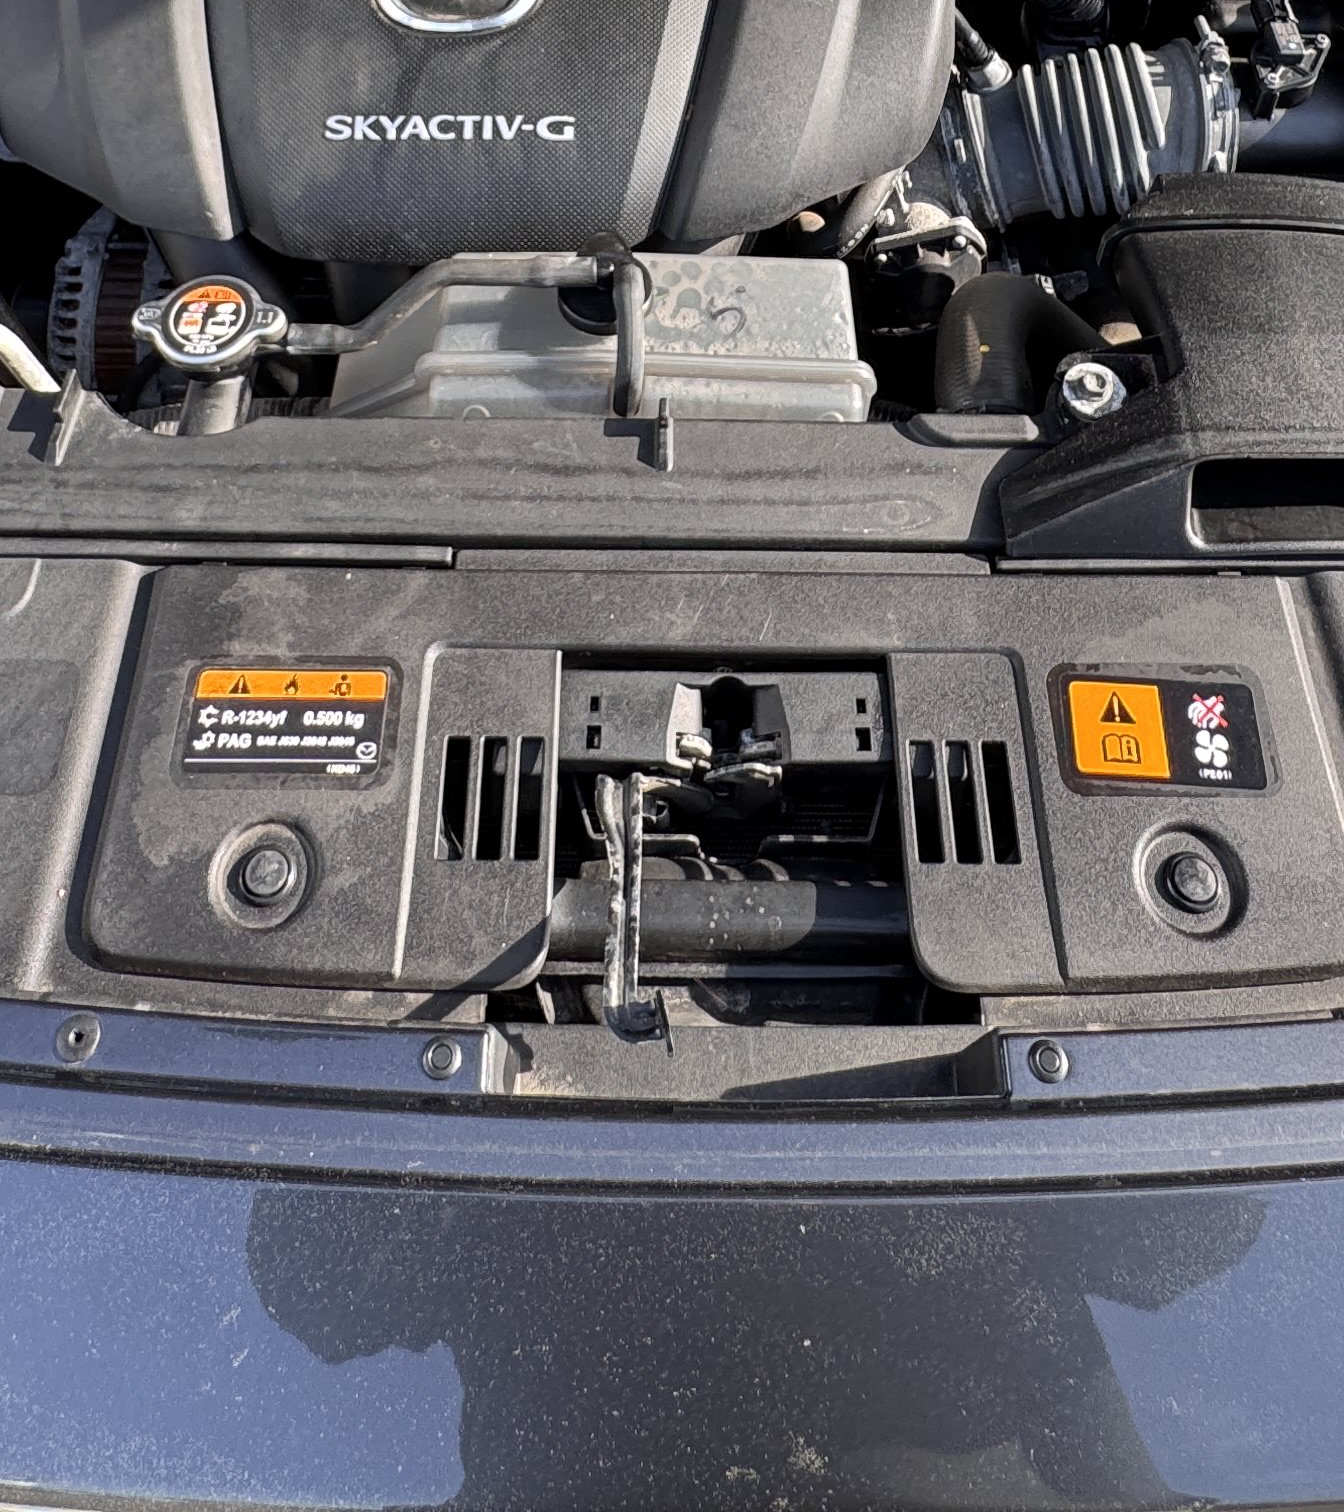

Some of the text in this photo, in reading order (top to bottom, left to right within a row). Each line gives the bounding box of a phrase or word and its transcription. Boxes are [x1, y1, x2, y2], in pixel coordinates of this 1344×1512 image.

[324, 114, 577, 141] SKYACTIV-G
[220, 709, 365, 729] R-1234yf 0.500 kg
[217, 732, 252, 749] PAG
